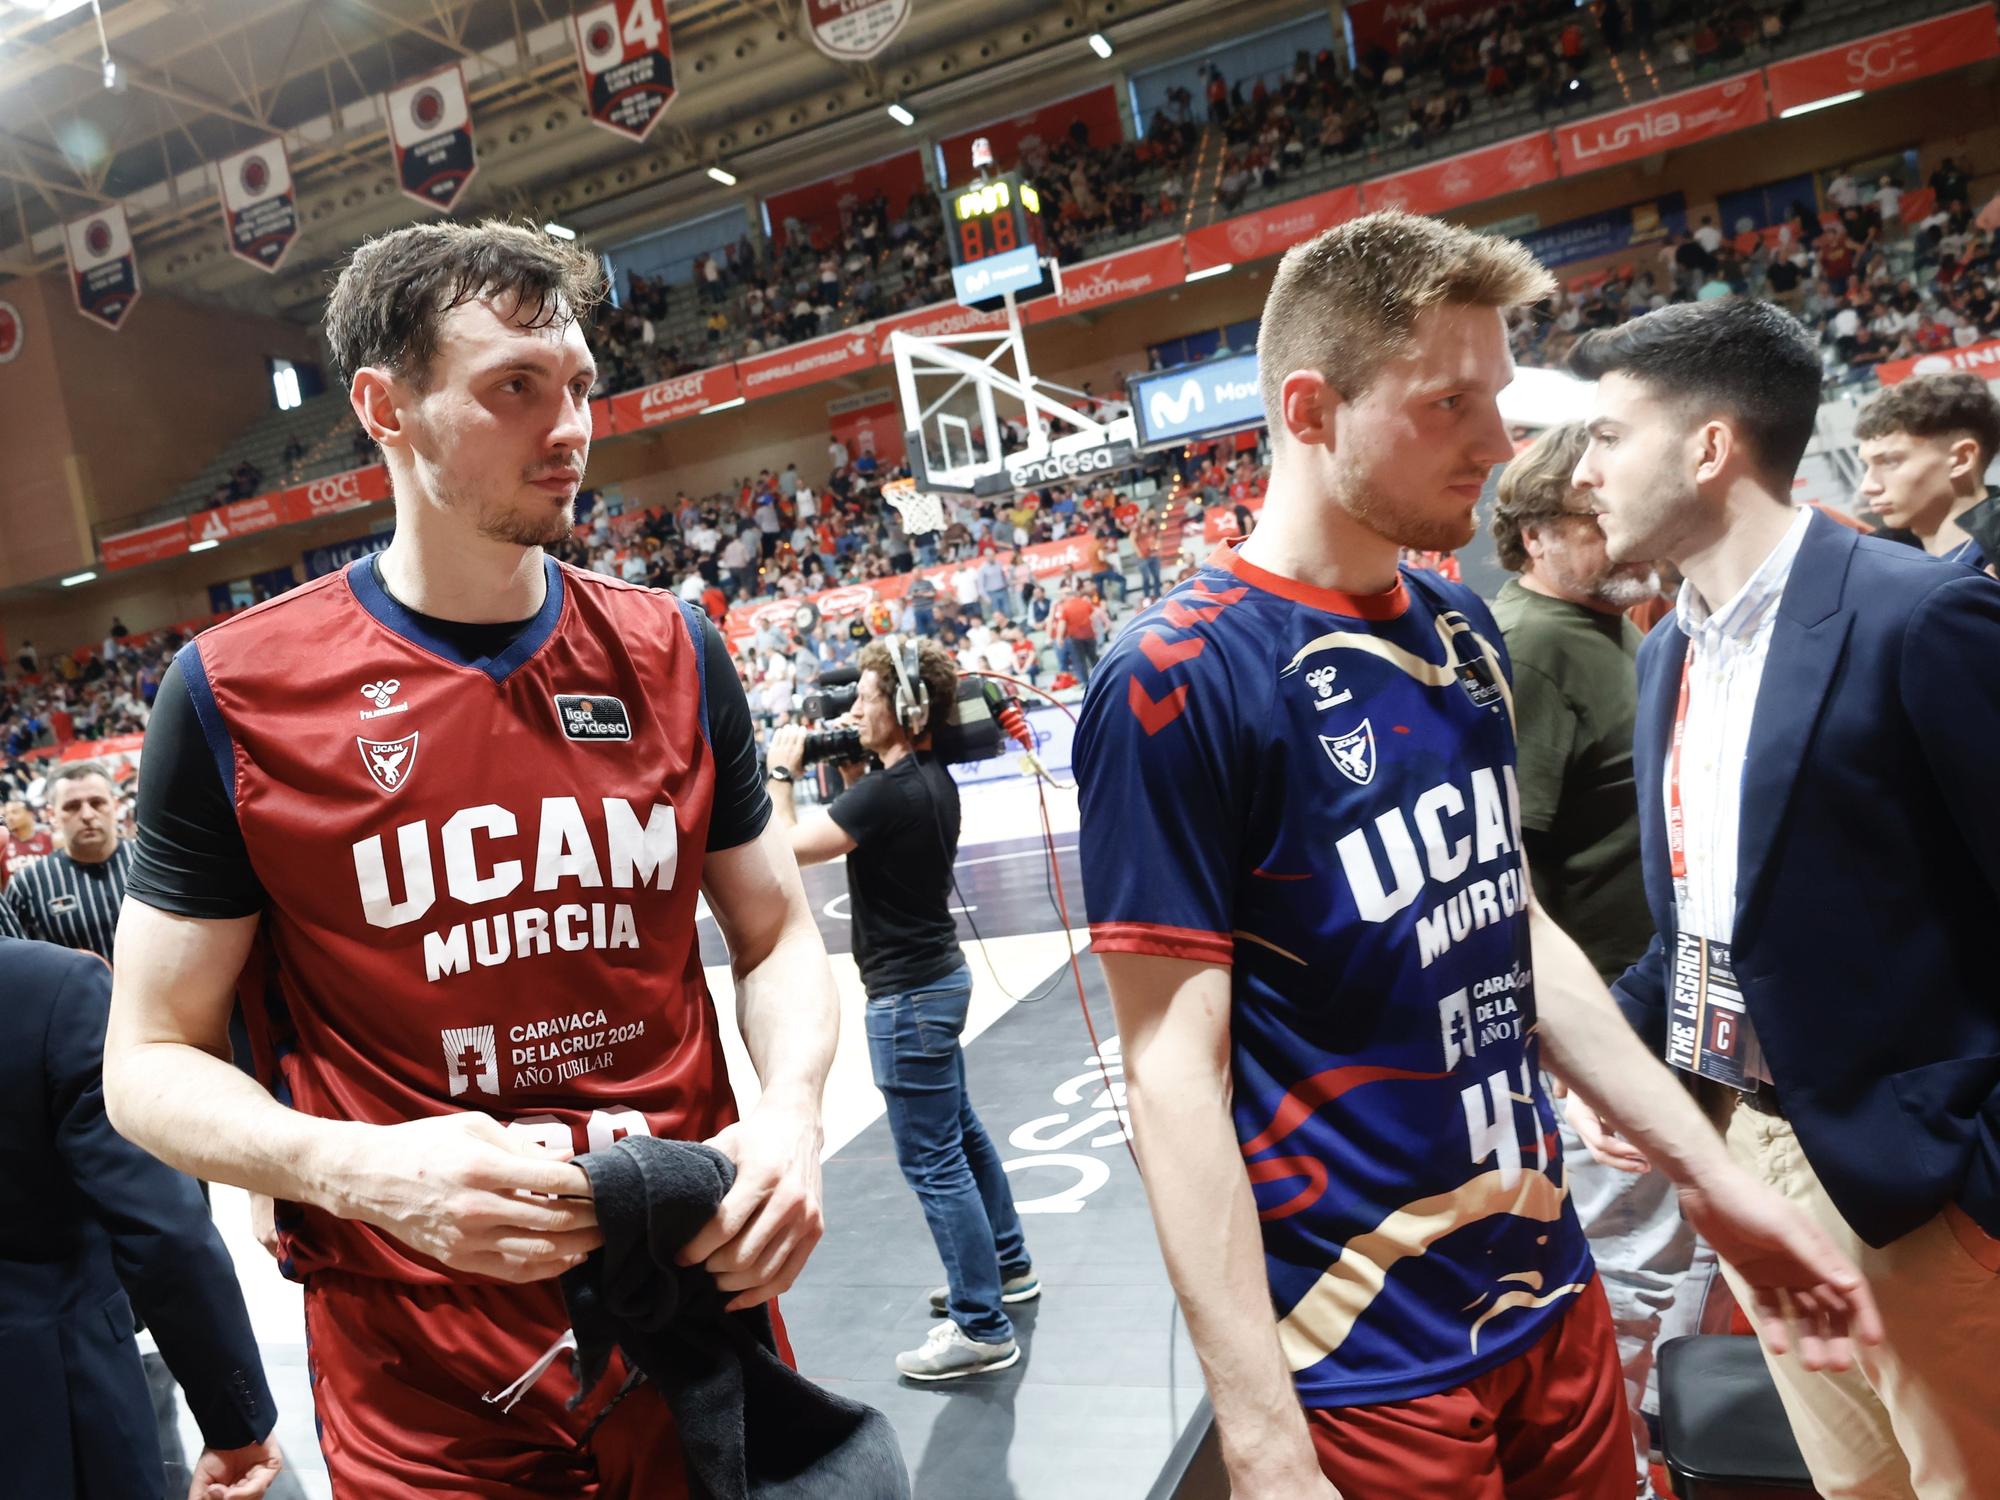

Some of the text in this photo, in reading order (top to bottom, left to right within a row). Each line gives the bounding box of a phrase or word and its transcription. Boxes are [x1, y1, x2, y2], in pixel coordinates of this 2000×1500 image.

[623, 0, 663, 50] 4
[651, 375, 704, 407] caser
[1010, 447, 1114, 488] endesa
[564, 706, 593, 723] liga
[569, 720, 627, 735] endesa
[372, 743, 404, 754] UCAM
[352, 796, 678, 929] UCAM
[423, 903, 640, 982] MURCIA
[1473, 973, 1517, 999] CARA
[1671, 932, 1701, 1065] THE LEGACY
[509, 1009, 608, 1042] CARAVACA
[1476, 997, 1517, 1023] DE LA
[512, 1021, 645, 1066] DE LA CRUZ 2024
[1480, 1022, 1511, 1047] AÑO
[1716, 1020, 1730, 1050] C
[514, 1052, 614, 1089] AÑO JUBILAR
